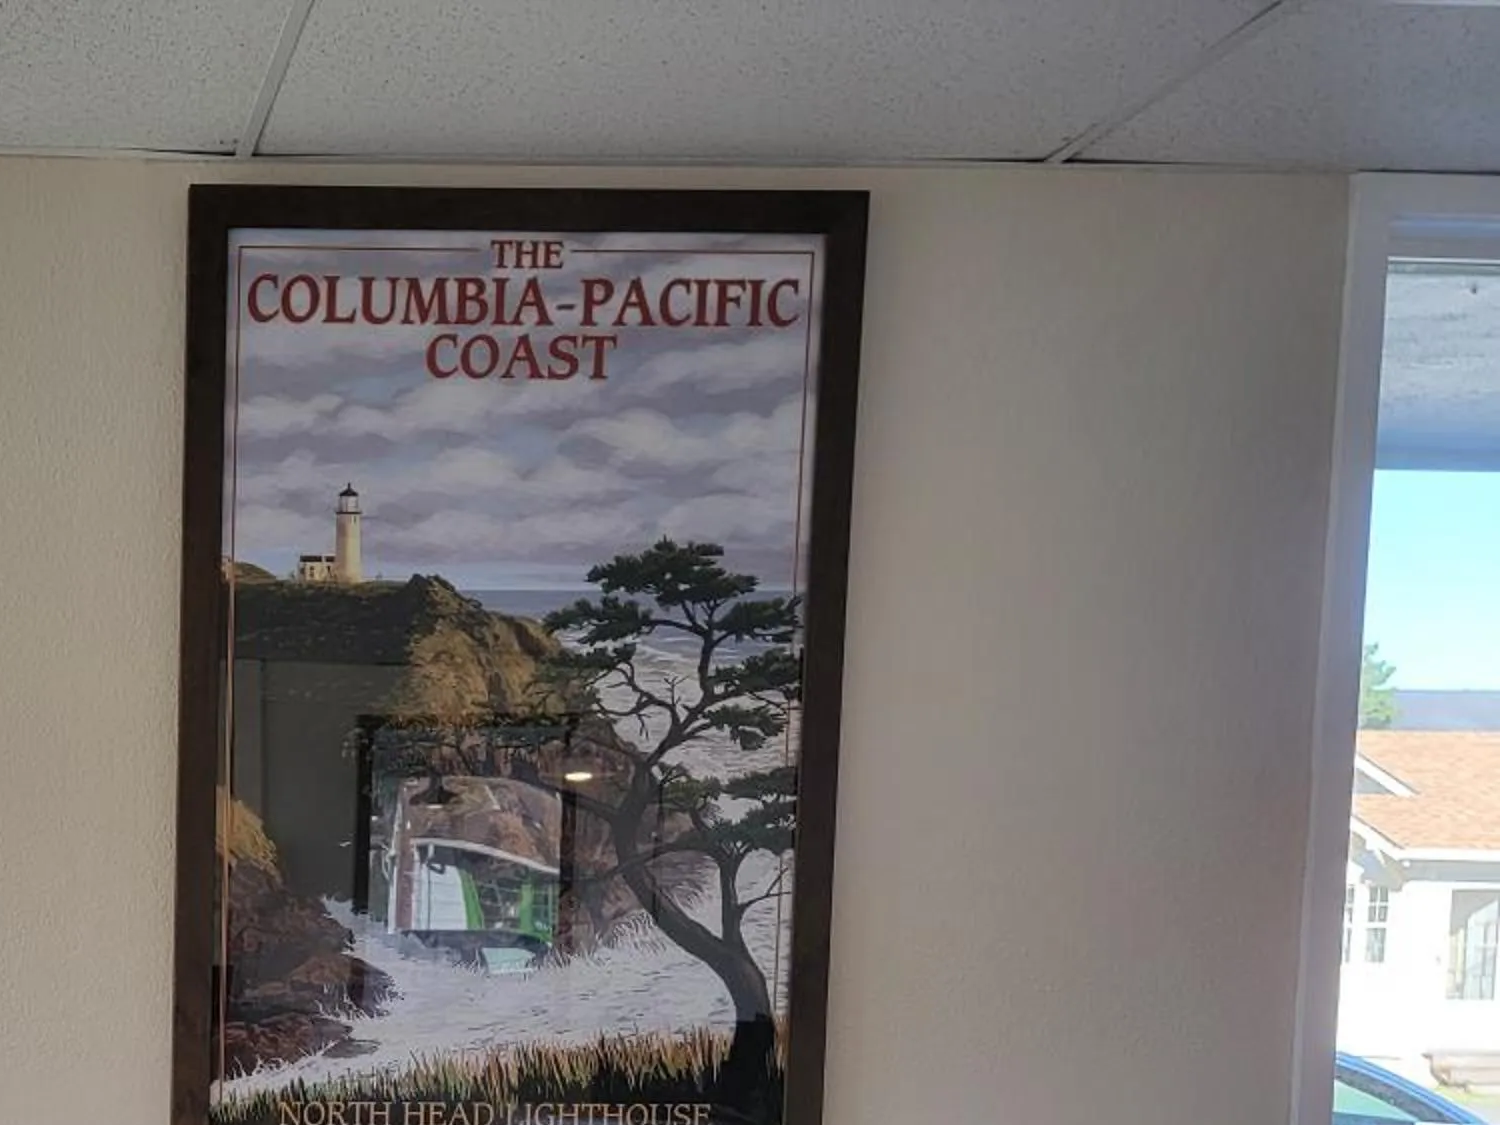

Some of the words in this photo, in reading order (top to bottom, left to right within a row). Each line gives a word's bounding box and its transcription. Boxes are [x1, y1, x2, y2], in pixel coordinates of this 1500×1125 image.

[490, 239, 565, 270] THE
[246, 273, 800, 327] COLUMBIA-PACIFIC
[425, 333, 618, 381] COAST
